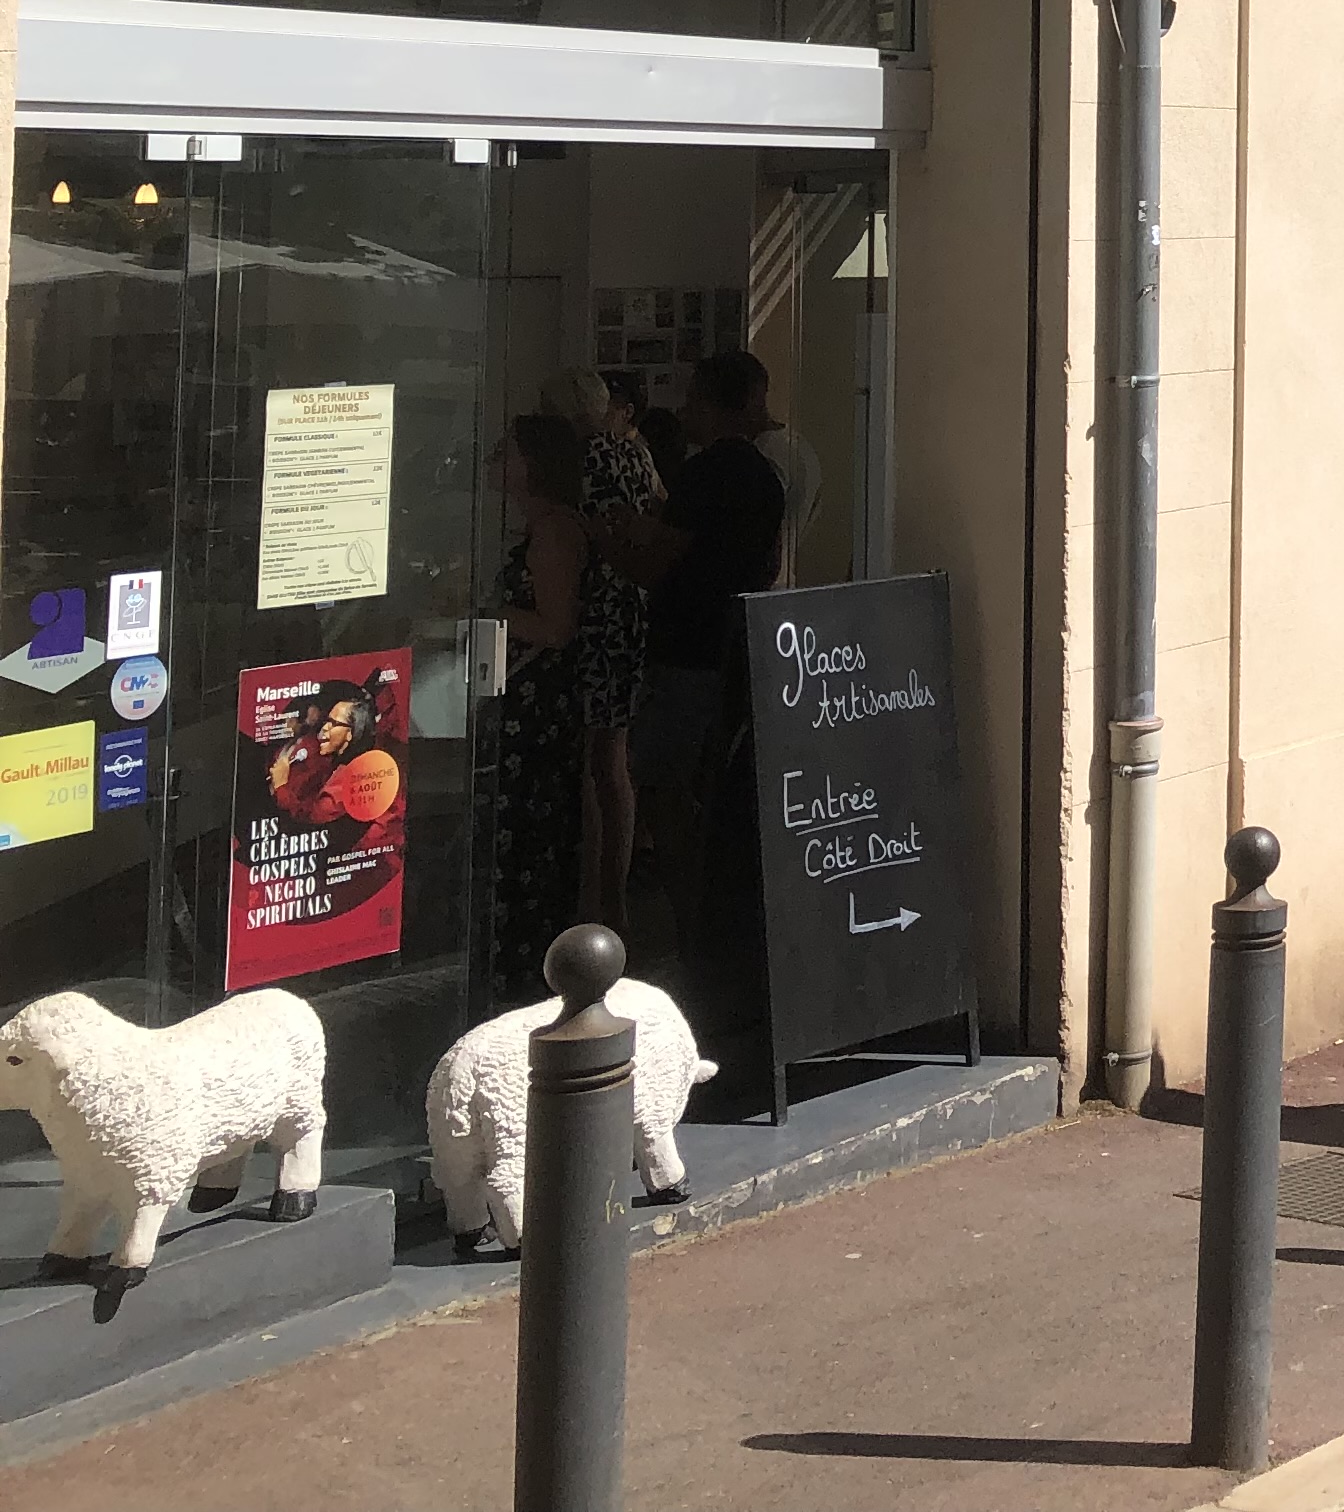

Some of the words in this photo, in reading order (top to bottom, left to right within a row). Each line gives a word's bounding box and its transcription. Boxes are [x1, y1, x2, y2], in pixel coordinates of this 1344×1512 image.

[292, 394, 315, 404] NOS
[317, 391, 370, 402] FORMULES
[304, 402, 360, 414] DÉJEUNERS
[294, 416, 316, 424] PLACE
[31, 656, 78, 670] ARTISAN
[256, 680, 321, 702] Marseille
[812, 668, 936, 730] Artisanales
[0, 763, 40, 784] Gault
[44, 756, 90, 775] Millau
[350, 768, 395, 783] DIMANCHE
[46, 784, 88, 806] 2019
[358, 780, 382, 794] AOÛT
[783, 770, 878, 829] Entrée
[251, 816, 279, 841] LES
[250, 829, 329, 863] CÉLÈBRES
[368, 847, 382, 856] FOR
[382, 844, 394, 852] ALL
[804, 835, 856, 878] Côté
[868, 821, 924, 866] Droit
[249, 854, 317, 886] GOSPELS
[264, 876, 316, 905] NEGRO
[246, 894, 332, 930] SPIRITUALS
